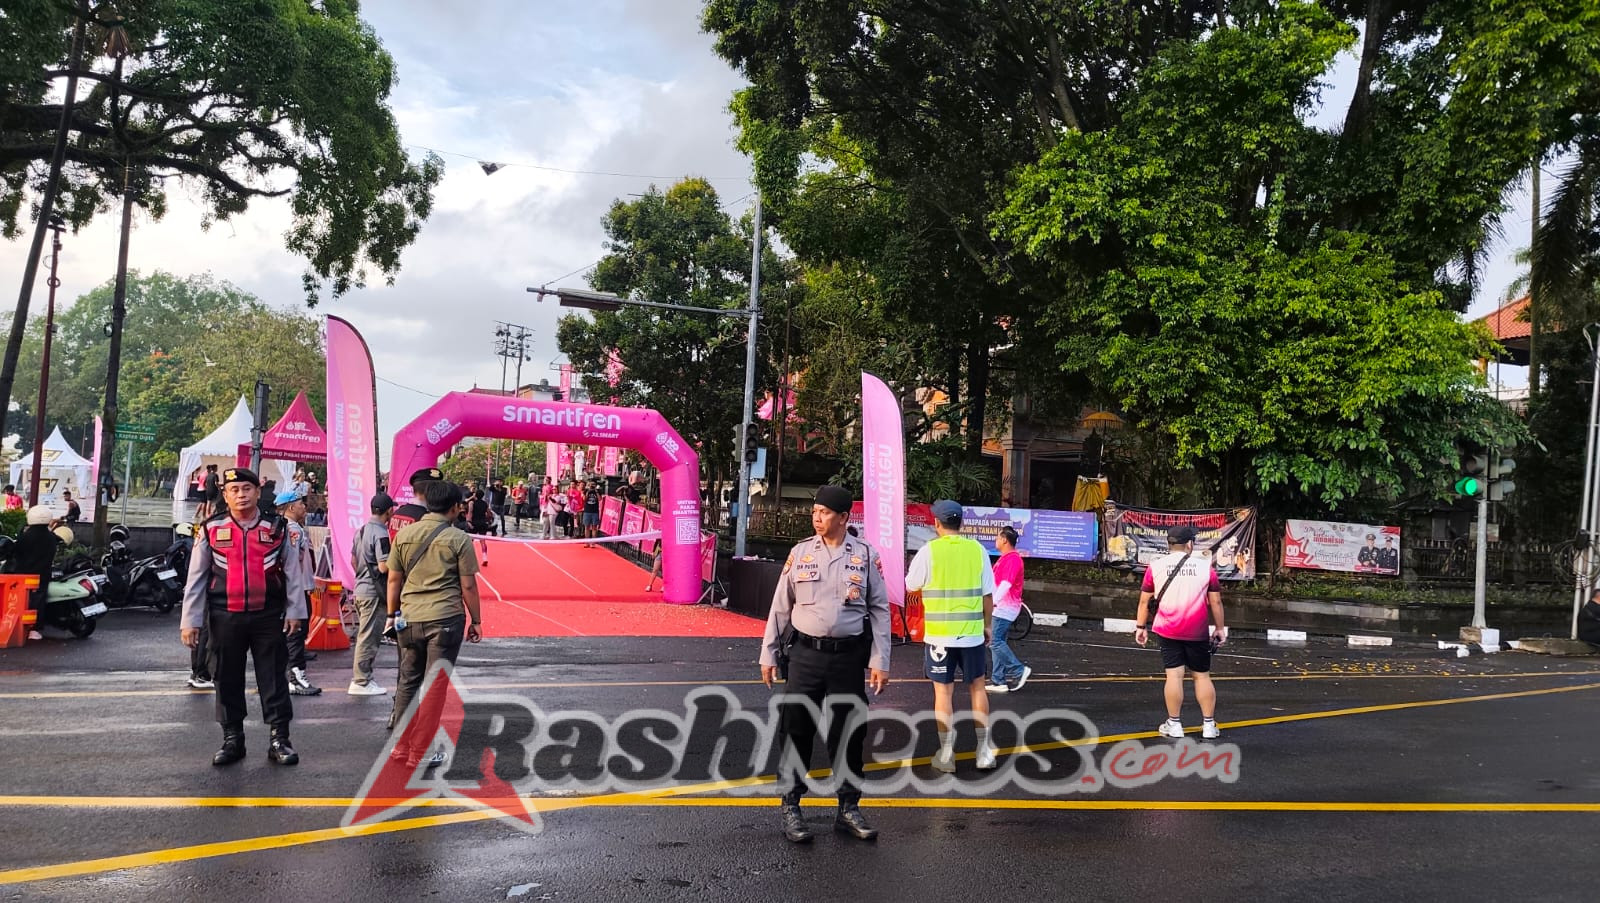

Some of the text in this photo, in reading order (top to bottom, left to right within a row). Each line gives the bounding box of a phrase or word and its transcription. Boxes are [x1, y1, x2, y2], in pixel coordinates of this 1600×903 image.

[502, 405, 621, 430] smartfren
[275, 431, 320, 443] smartfren
[1166, 568, 1197, 576] OICIAL
